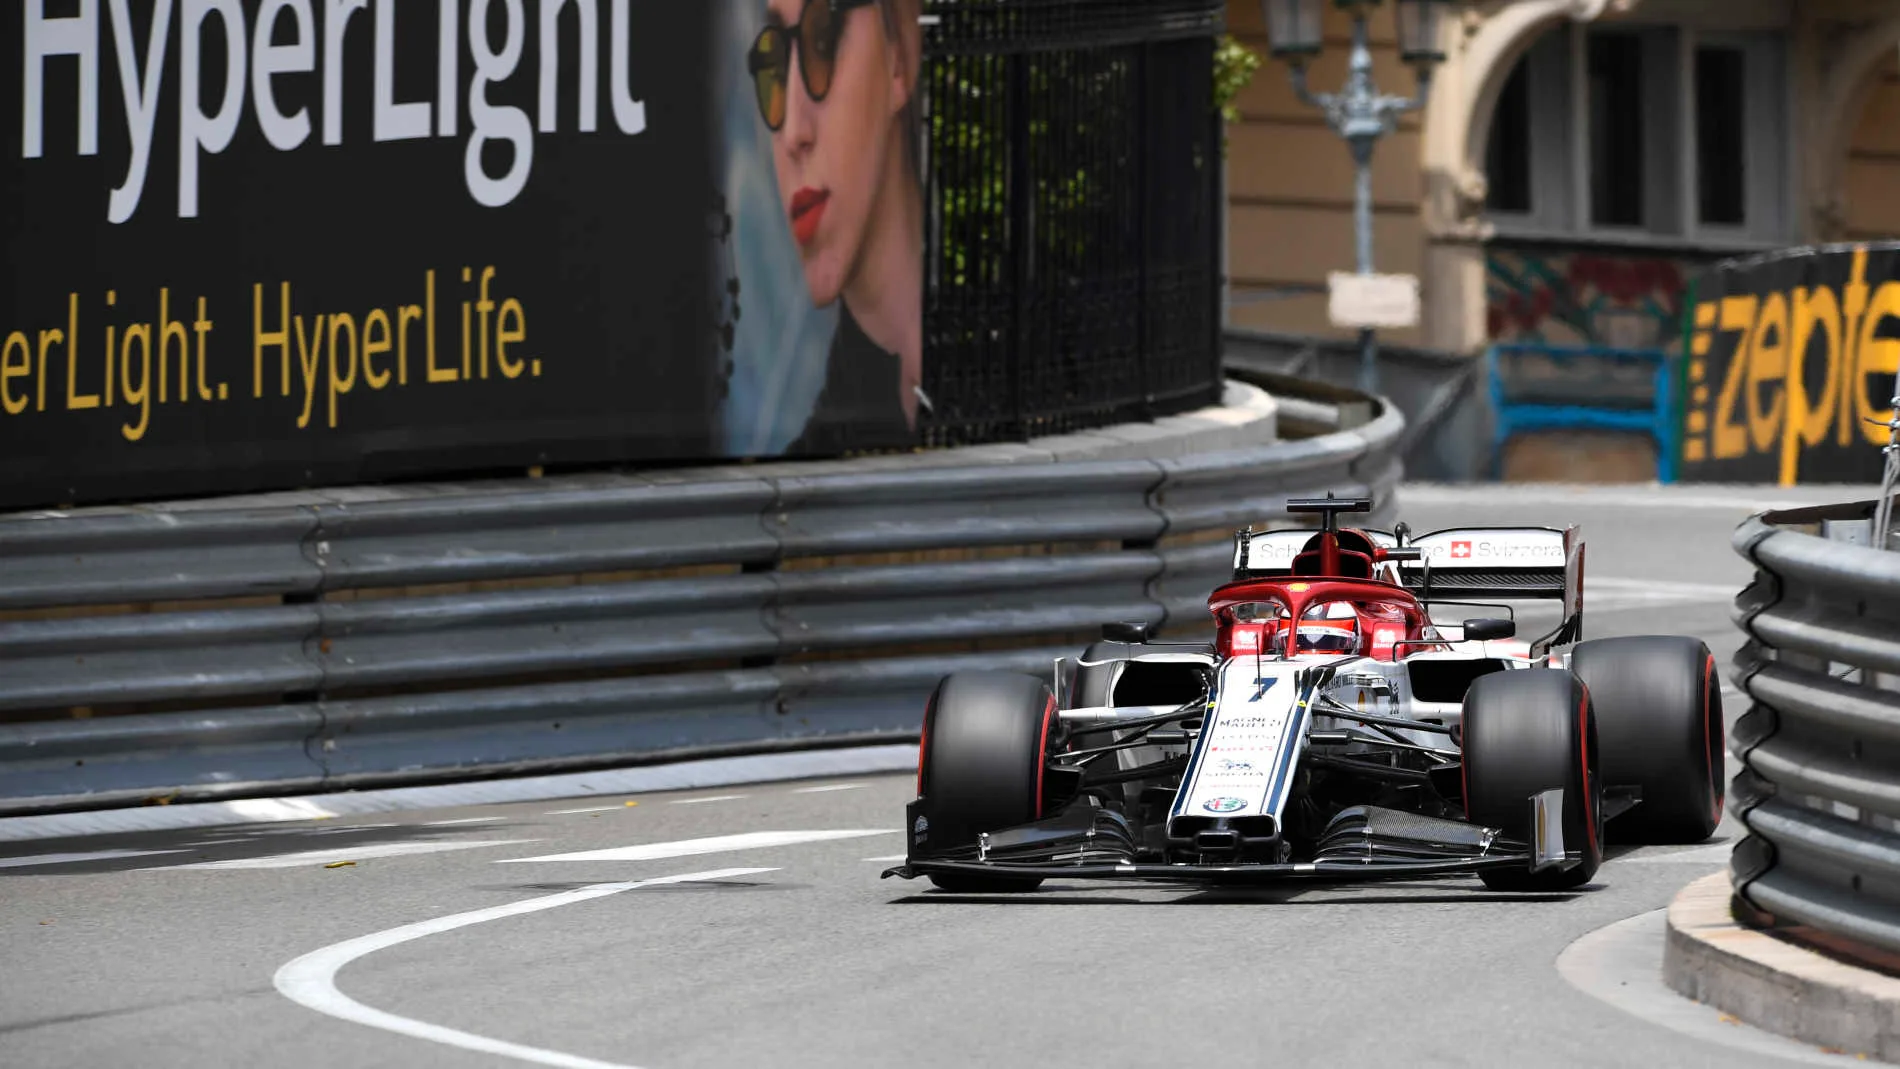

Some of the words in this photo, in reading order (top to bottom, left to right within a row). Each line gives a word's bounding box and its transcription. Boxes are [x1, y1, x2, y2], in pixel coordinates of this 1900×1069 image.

[22, 0, 647, 224] HyperLight
[253, 266, 541, 428] HyperLife.
[1248, 676, 1279, 703] 7
